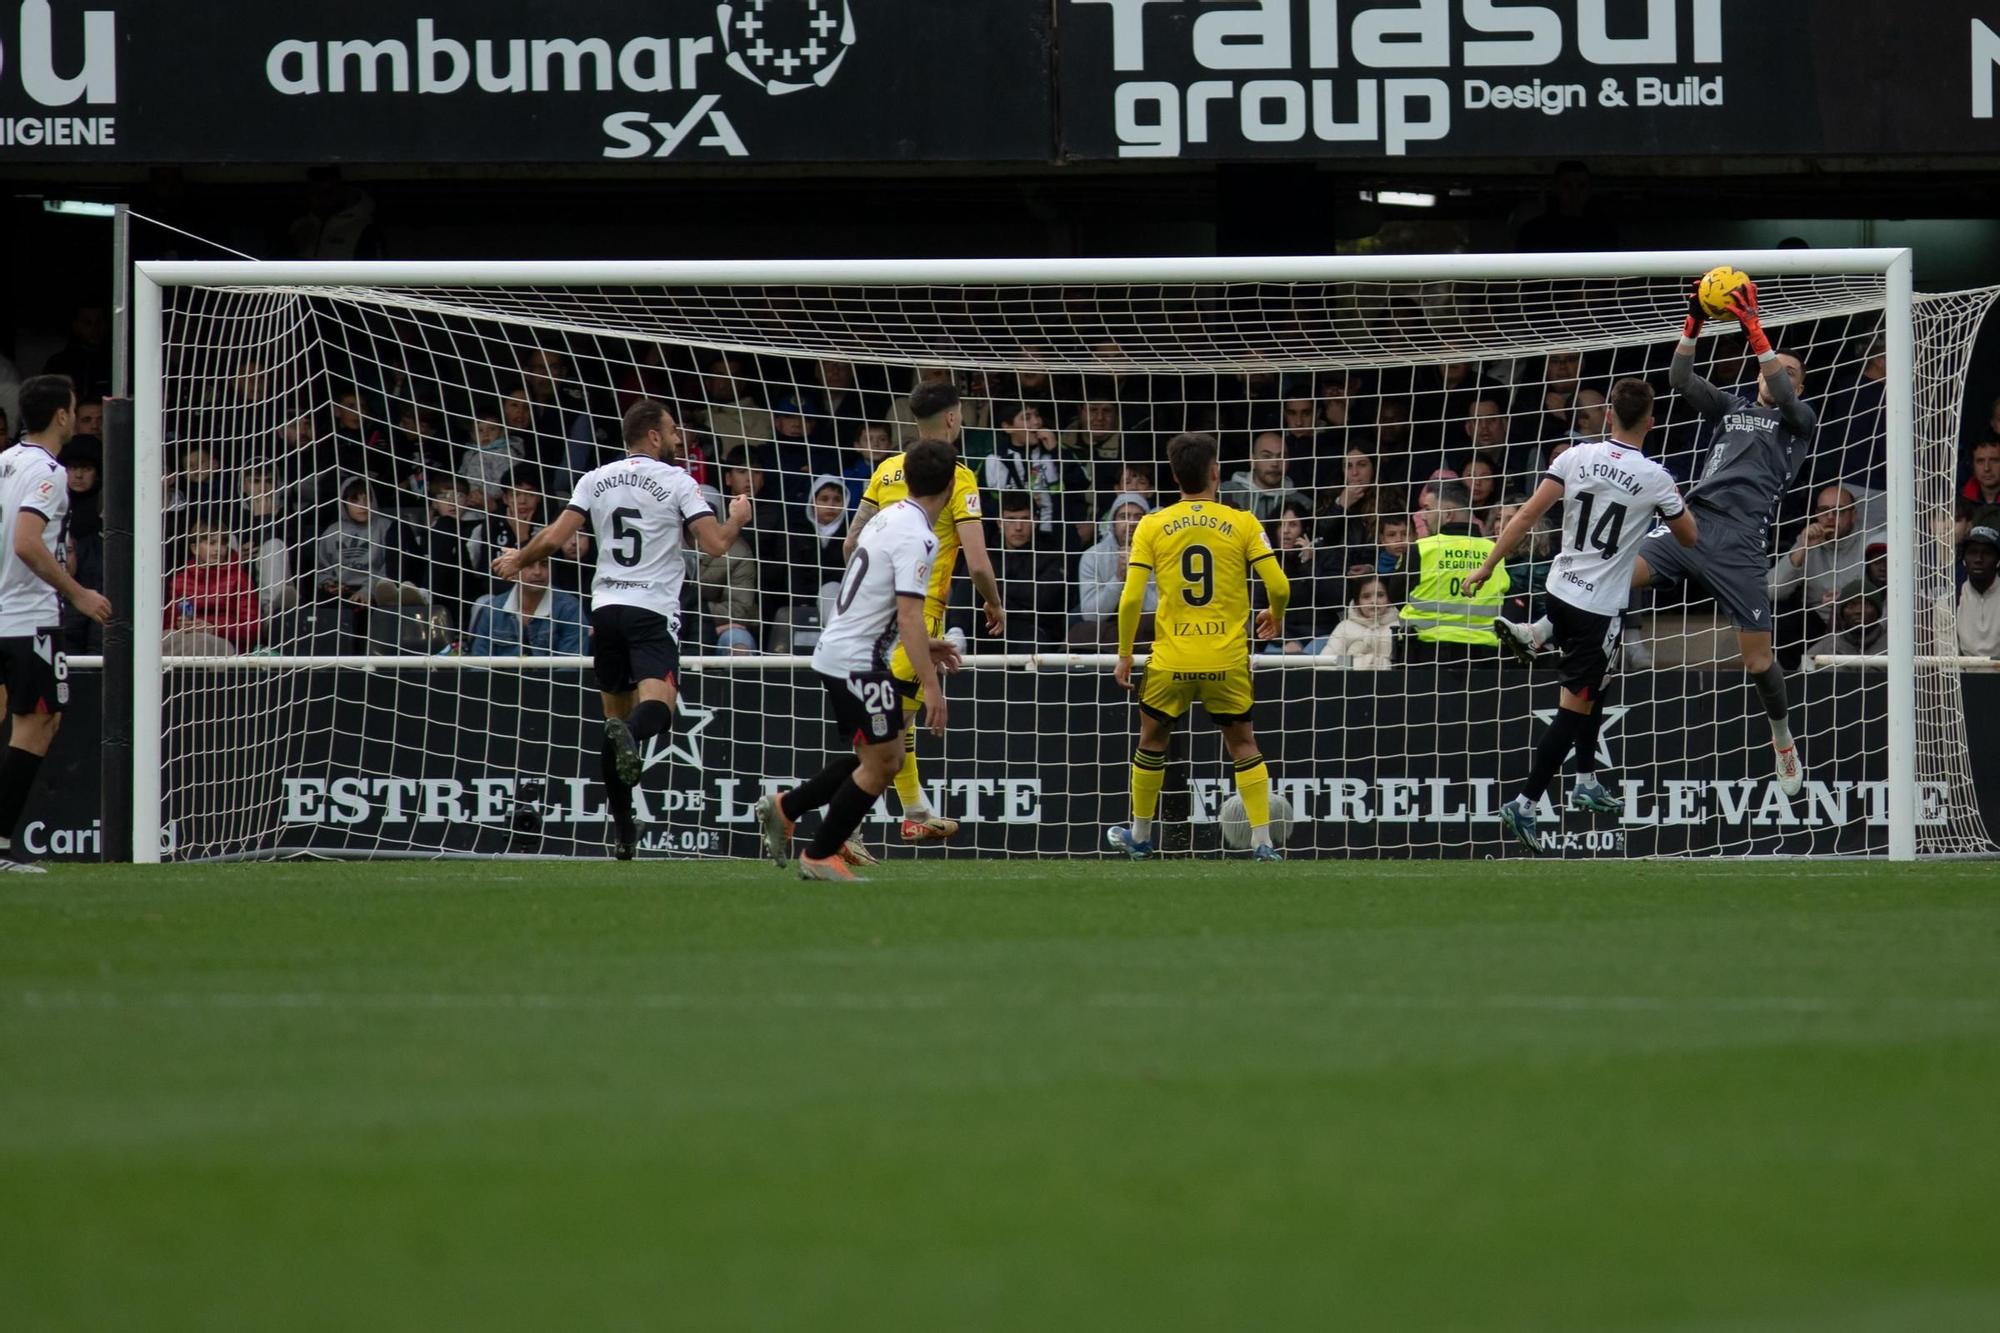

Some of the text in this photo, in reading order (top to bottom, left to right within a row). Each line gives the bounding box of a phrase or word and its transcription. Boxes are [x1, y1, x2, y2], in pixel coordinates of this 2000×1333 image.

[266, 18, 714, 95] ambumar
[1463, 76, 1723, 115] Design & Build
[0, 117, 115, 146] IGIENE
[1114, 78, 1450, 158] group
[1579, 464, 1643, 496] J. FONTÁN
[612, 507, 642, 567] 5
[1163, 515, 1217, 535] CARLOS
[1574, 491, 1628, 561] 14
[1181, 544, 1214, 607] 9
[1173, 621, 1226, 636] IZADI
[54, 651, 69, 681] 6
[864, 680, 895, 714] 20
[661, 790, 706, 811] DE
[1618, 779, 1949, 826] LEVANTE
